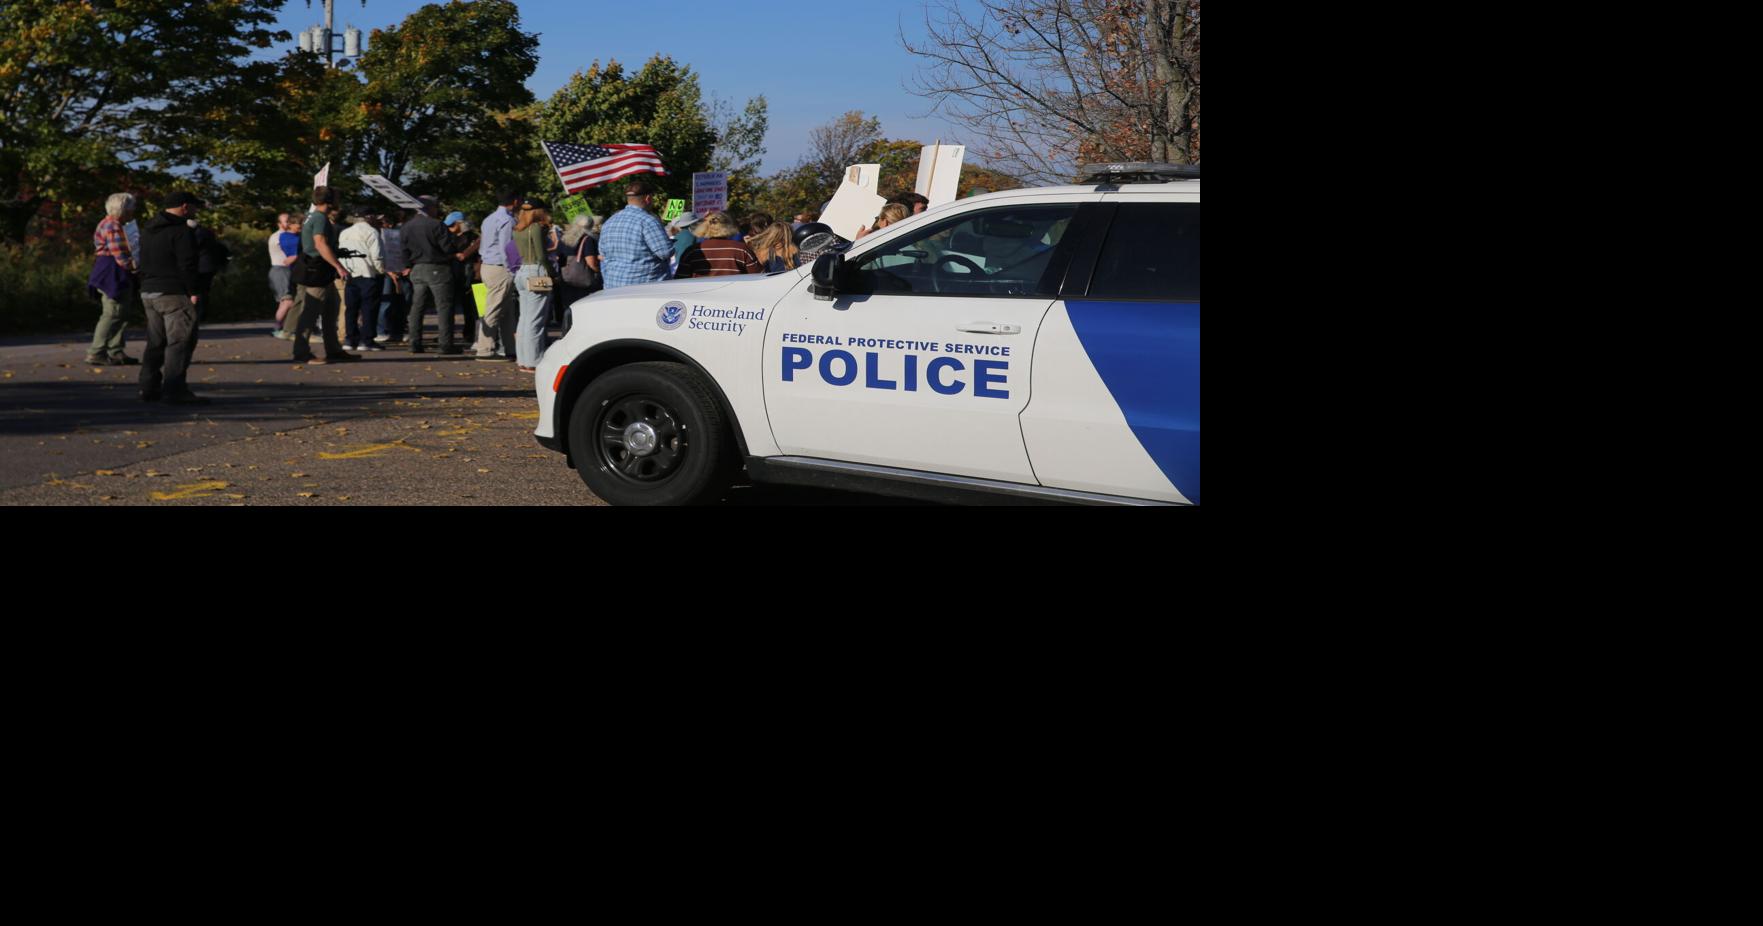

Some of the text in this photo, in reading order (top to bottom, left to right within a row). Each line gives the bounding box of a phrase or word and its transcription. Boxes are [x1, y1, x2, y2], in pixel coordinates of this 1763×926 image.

[669, 199, 683, 210] NO
[691, 305, 765, 321] Homeland
[688, 317, 746, 336] Security
[782, 333, 1010, 357] FEDERAL PROTECTIVE SERVICE
[781, 346, 1010, 399] POLICE
